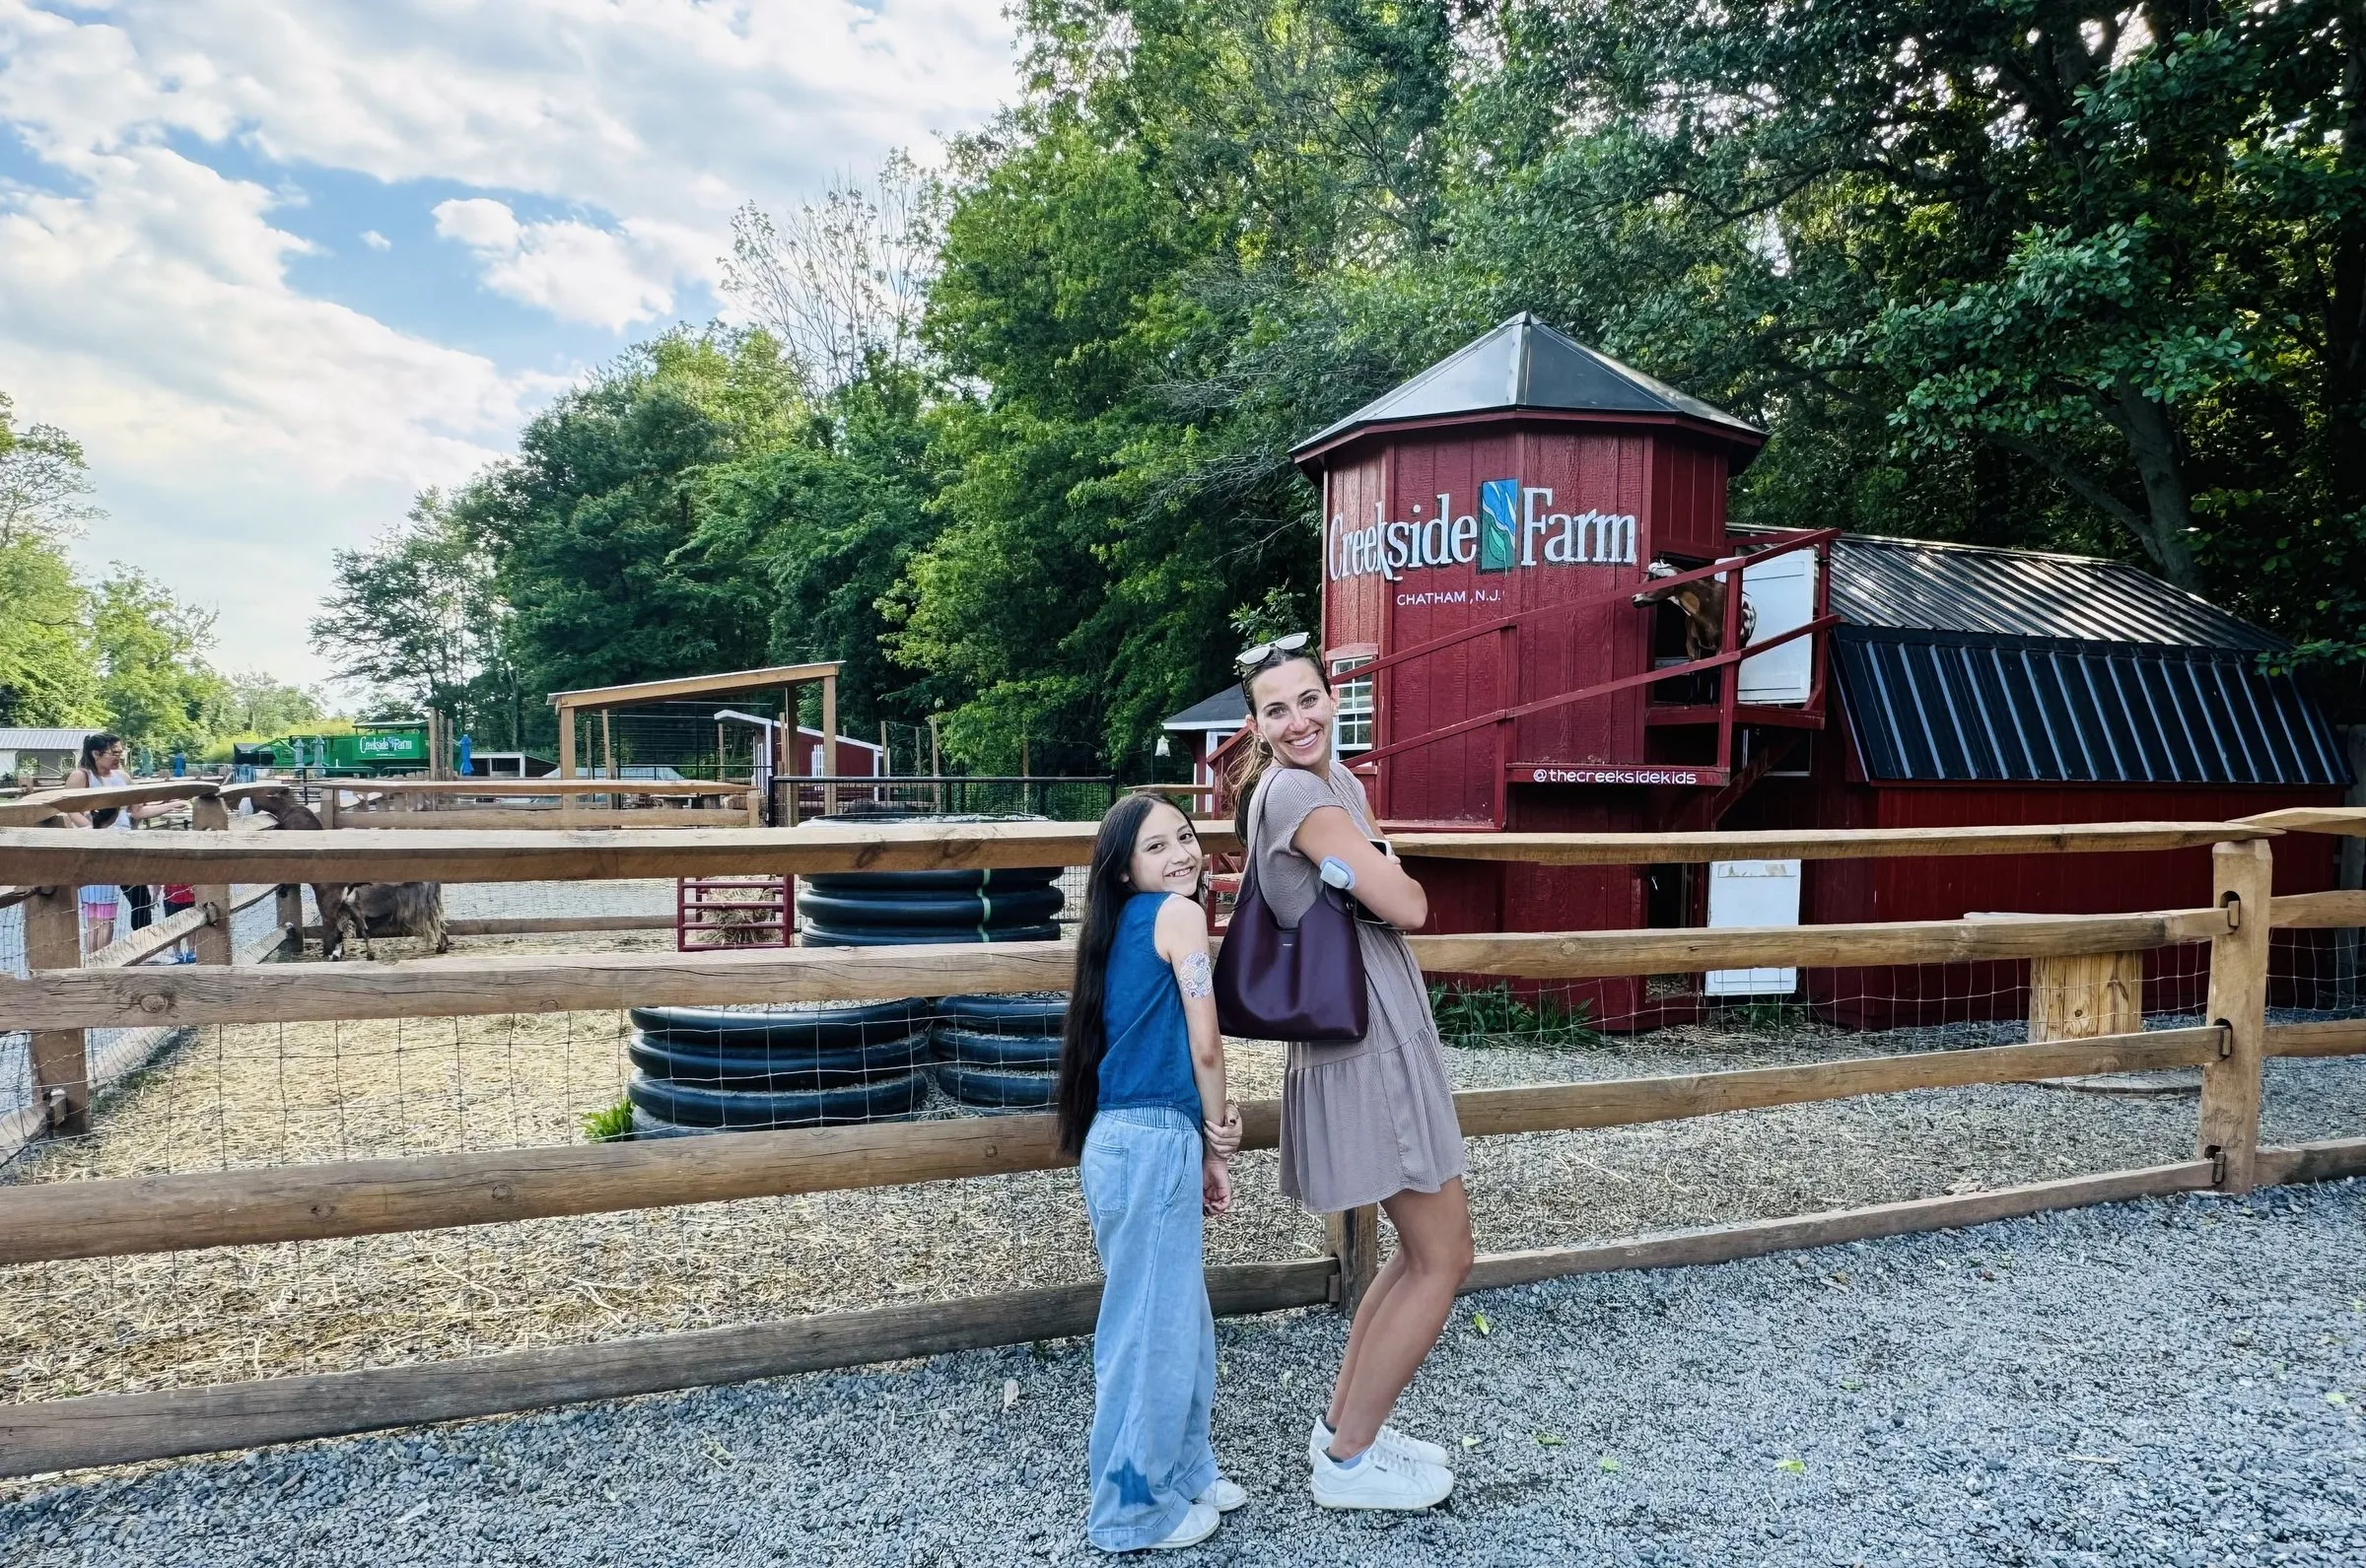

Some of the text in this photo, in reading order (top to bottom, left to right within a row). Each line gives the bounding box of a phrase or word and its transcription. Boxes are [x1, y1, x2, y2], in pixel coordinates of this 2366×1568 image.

[1329, 487, 1637, 581] Creekside Farm
[1533, 769, 1697, 784] @thecreeksidekids
